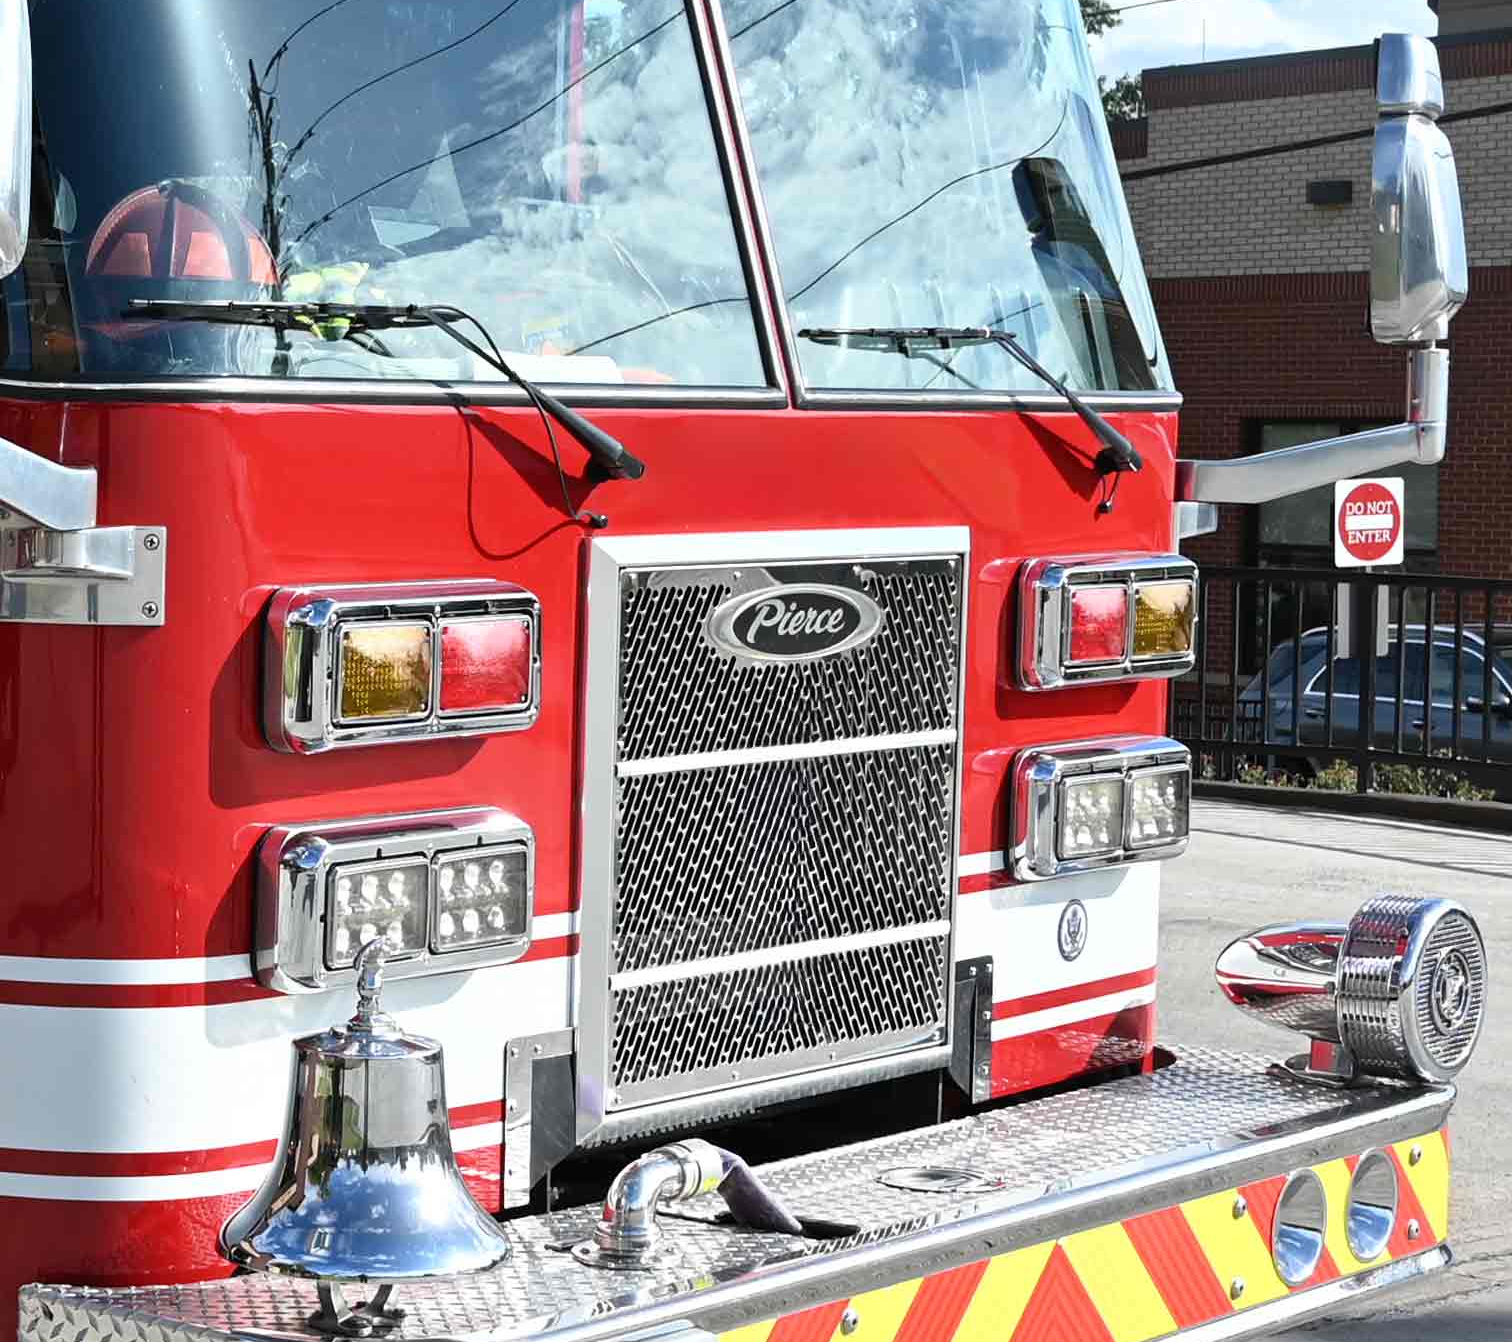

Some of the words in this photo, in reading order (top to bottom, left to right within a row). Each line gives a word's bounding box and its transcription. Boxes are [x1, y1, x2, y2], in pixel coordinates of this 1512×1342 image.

[1345, 502, 1364, 515] DO
[1366, 500, 1394, 515] NOT
[1347, 530, 1392, 544] ENTER
[746, 598, 845, 644] Pierce
